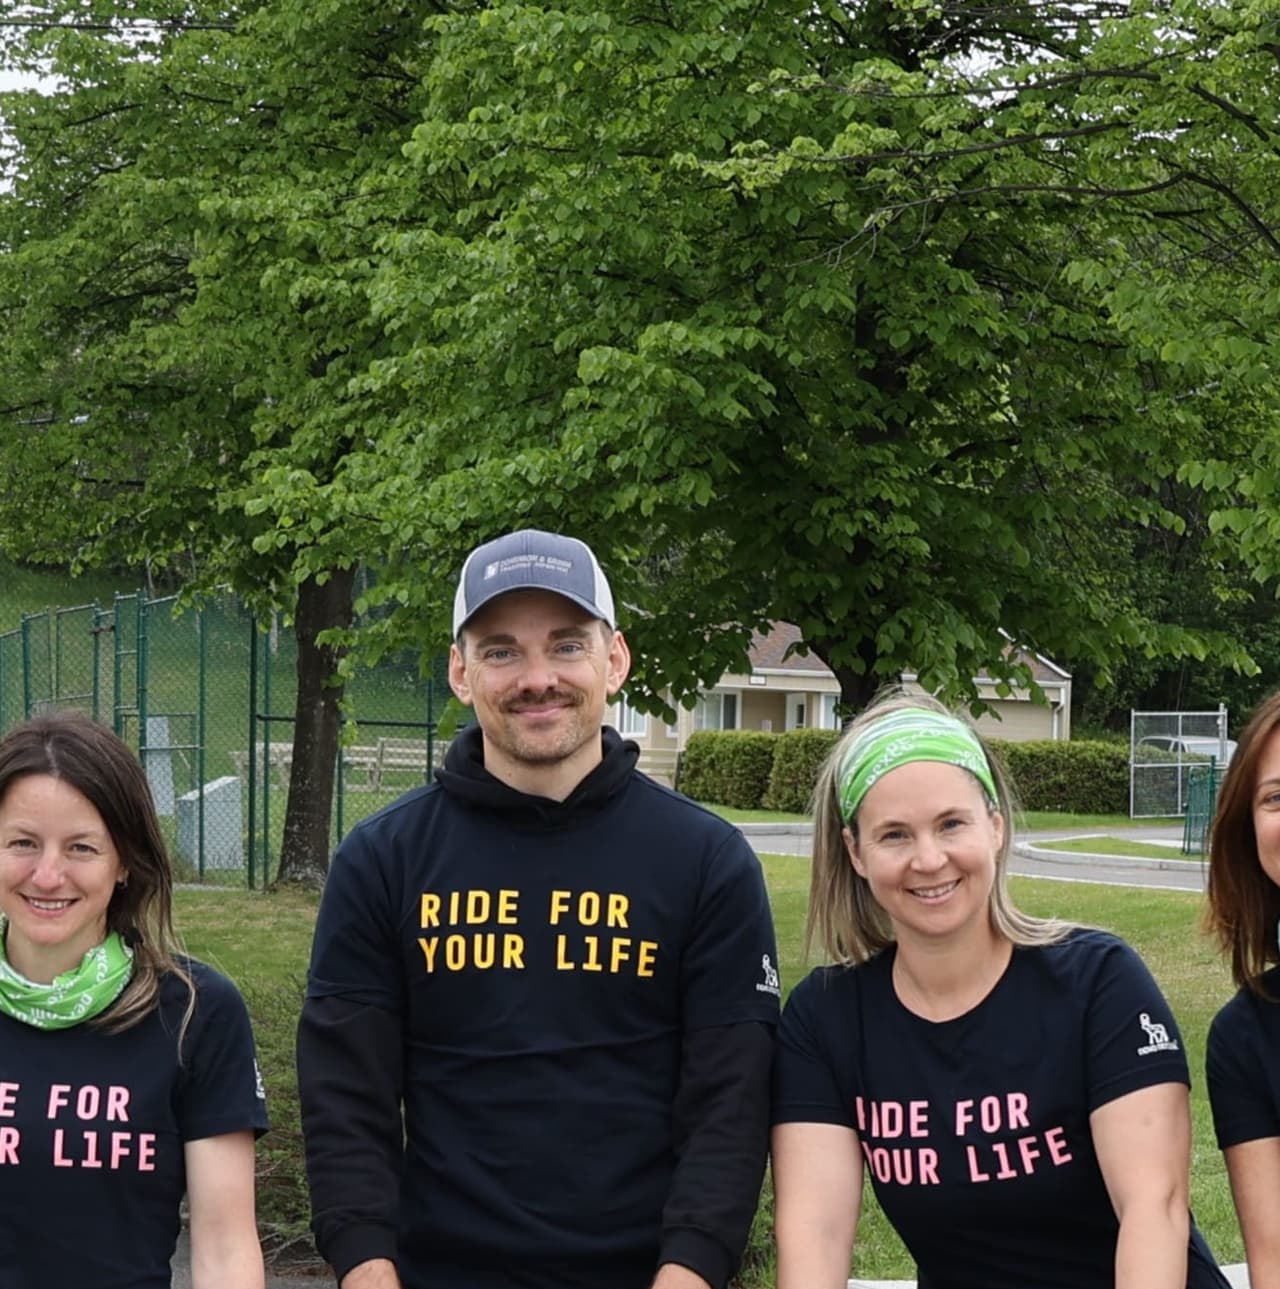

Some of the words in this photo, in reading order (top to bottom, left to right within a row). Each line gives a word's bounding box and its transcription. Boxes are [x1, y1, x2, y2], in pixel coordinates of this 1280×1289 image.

[419, 890, 521, 929] RIDE
[549, 890, 631, 929] FOR
[418, 933, 526, 973] YOUR
[47, 1084, 131, 1123] FOR
[955, 1092, 1031, 1136] FOR
